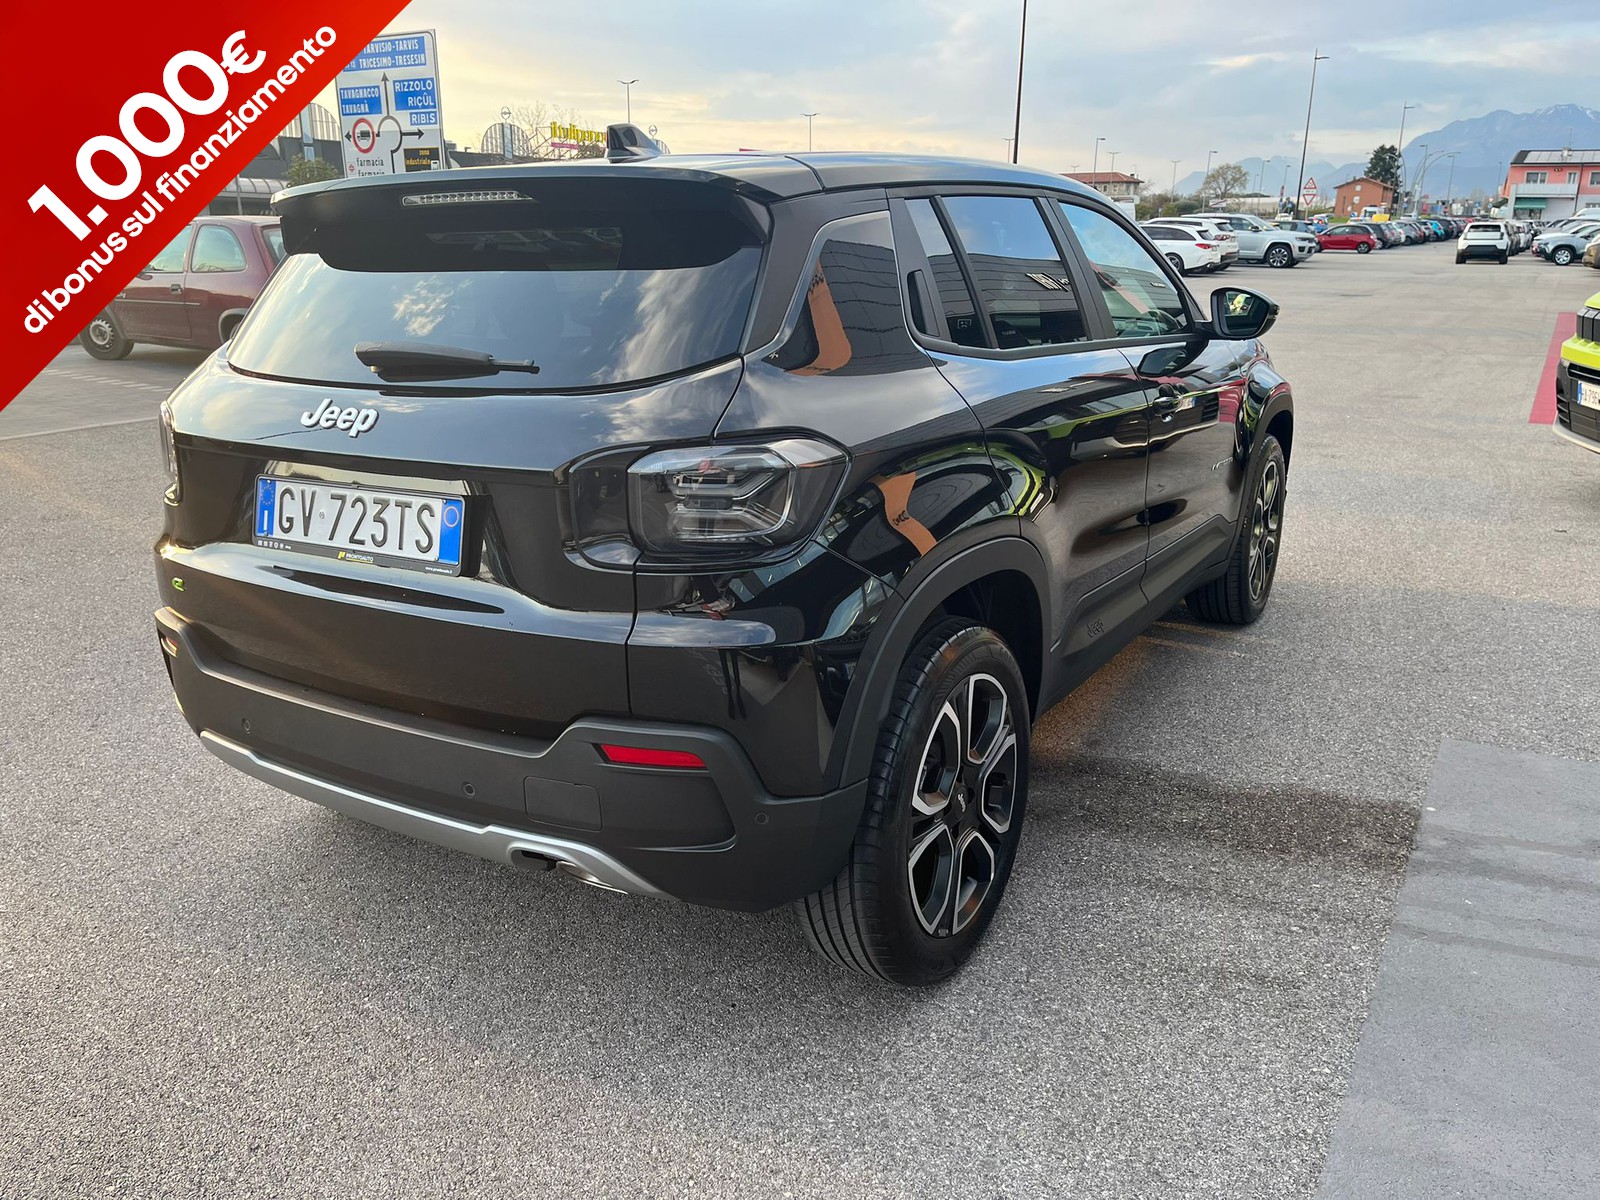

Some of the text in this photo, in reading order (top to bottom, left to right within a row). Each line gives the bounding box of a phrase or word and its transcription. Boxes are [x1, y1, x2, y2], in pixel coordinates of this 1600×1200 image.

[395, 80, 433, 92] RIZZOLO
[341, 87, 380, 100] TAVAGNACCO
[342, 100, 370, 114] TAVAGNÀ
[411, 113, 436, 124] RIBIS
[357, 157, 384, 167] farmacia
[301, 399, 379, 438] Jeep
[278, 486, 317, 537] GV
[328, 492, 436, 553] 723TS
